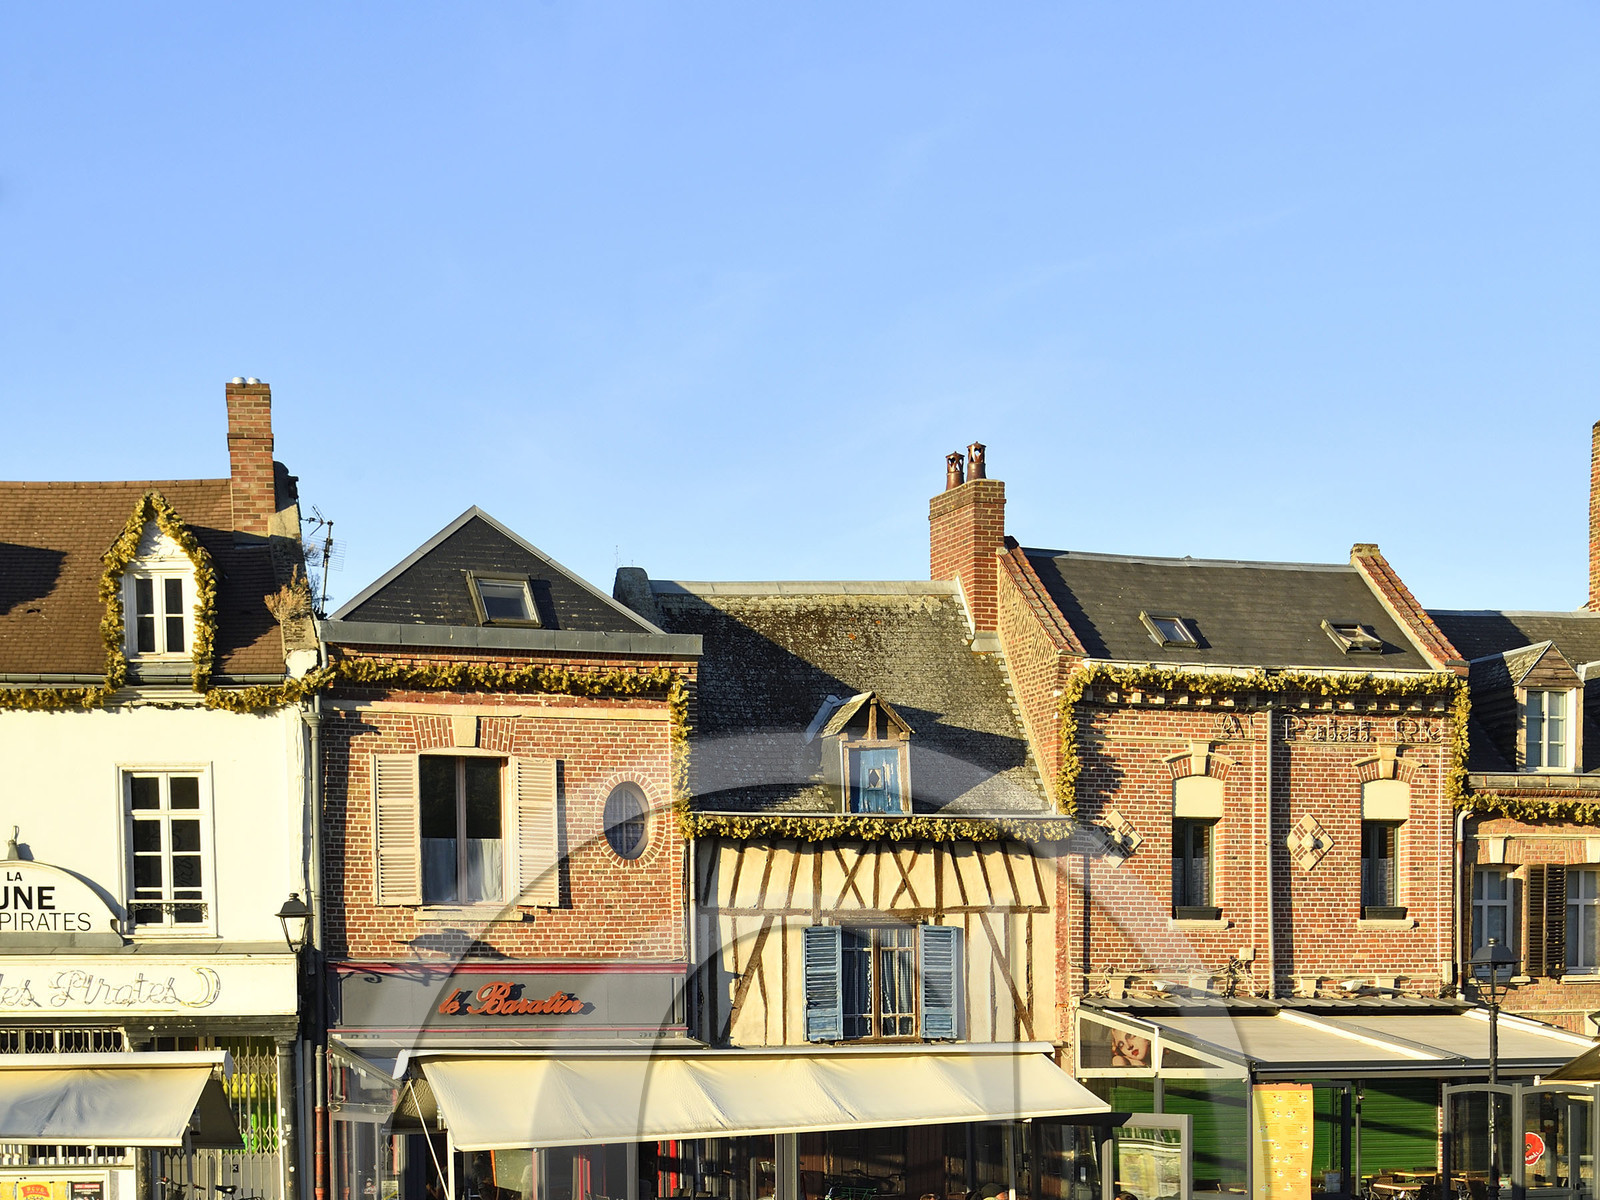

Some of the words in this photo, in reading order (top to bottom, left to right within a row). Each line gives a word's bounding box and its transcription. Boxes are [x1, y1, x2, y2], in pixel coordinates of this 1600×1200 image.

[7, 872, 23, 881] LA
[0, 912, 91, 931] PIRATES
[49, 969, 180, 1008] Pirates
[466, 981, 584, 1015] Baratin
